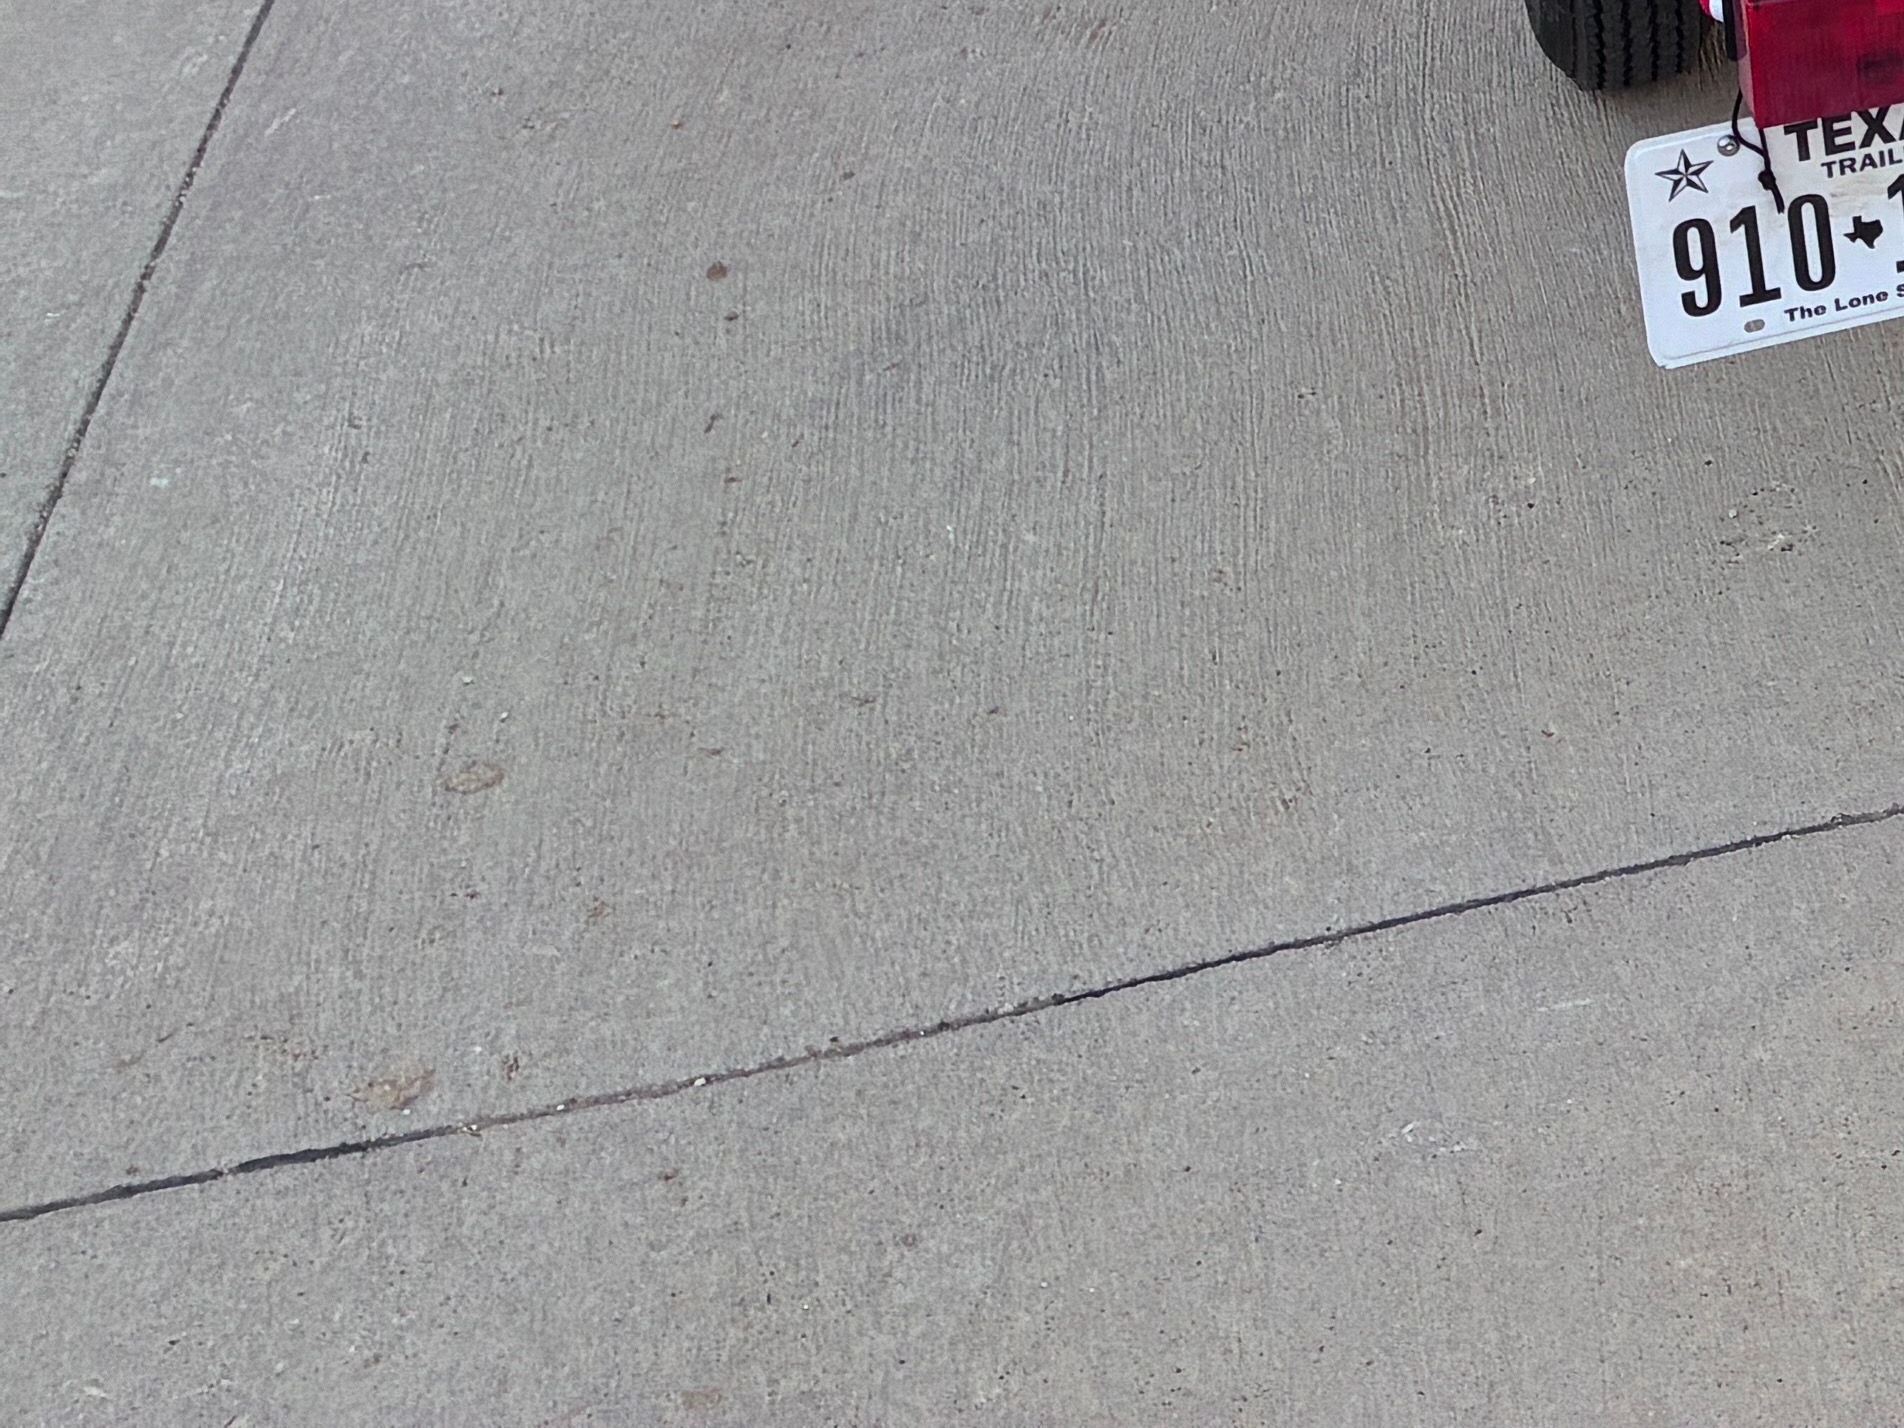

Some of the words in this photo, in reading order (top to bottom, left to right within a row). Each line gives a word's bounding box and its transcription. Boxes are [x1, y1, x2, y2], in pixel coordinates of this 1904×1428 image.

[1672, 193, 1836, 317] 910
[1784, 303, 1827, 323] The
[1835, 288, 1889, 312] Lone
